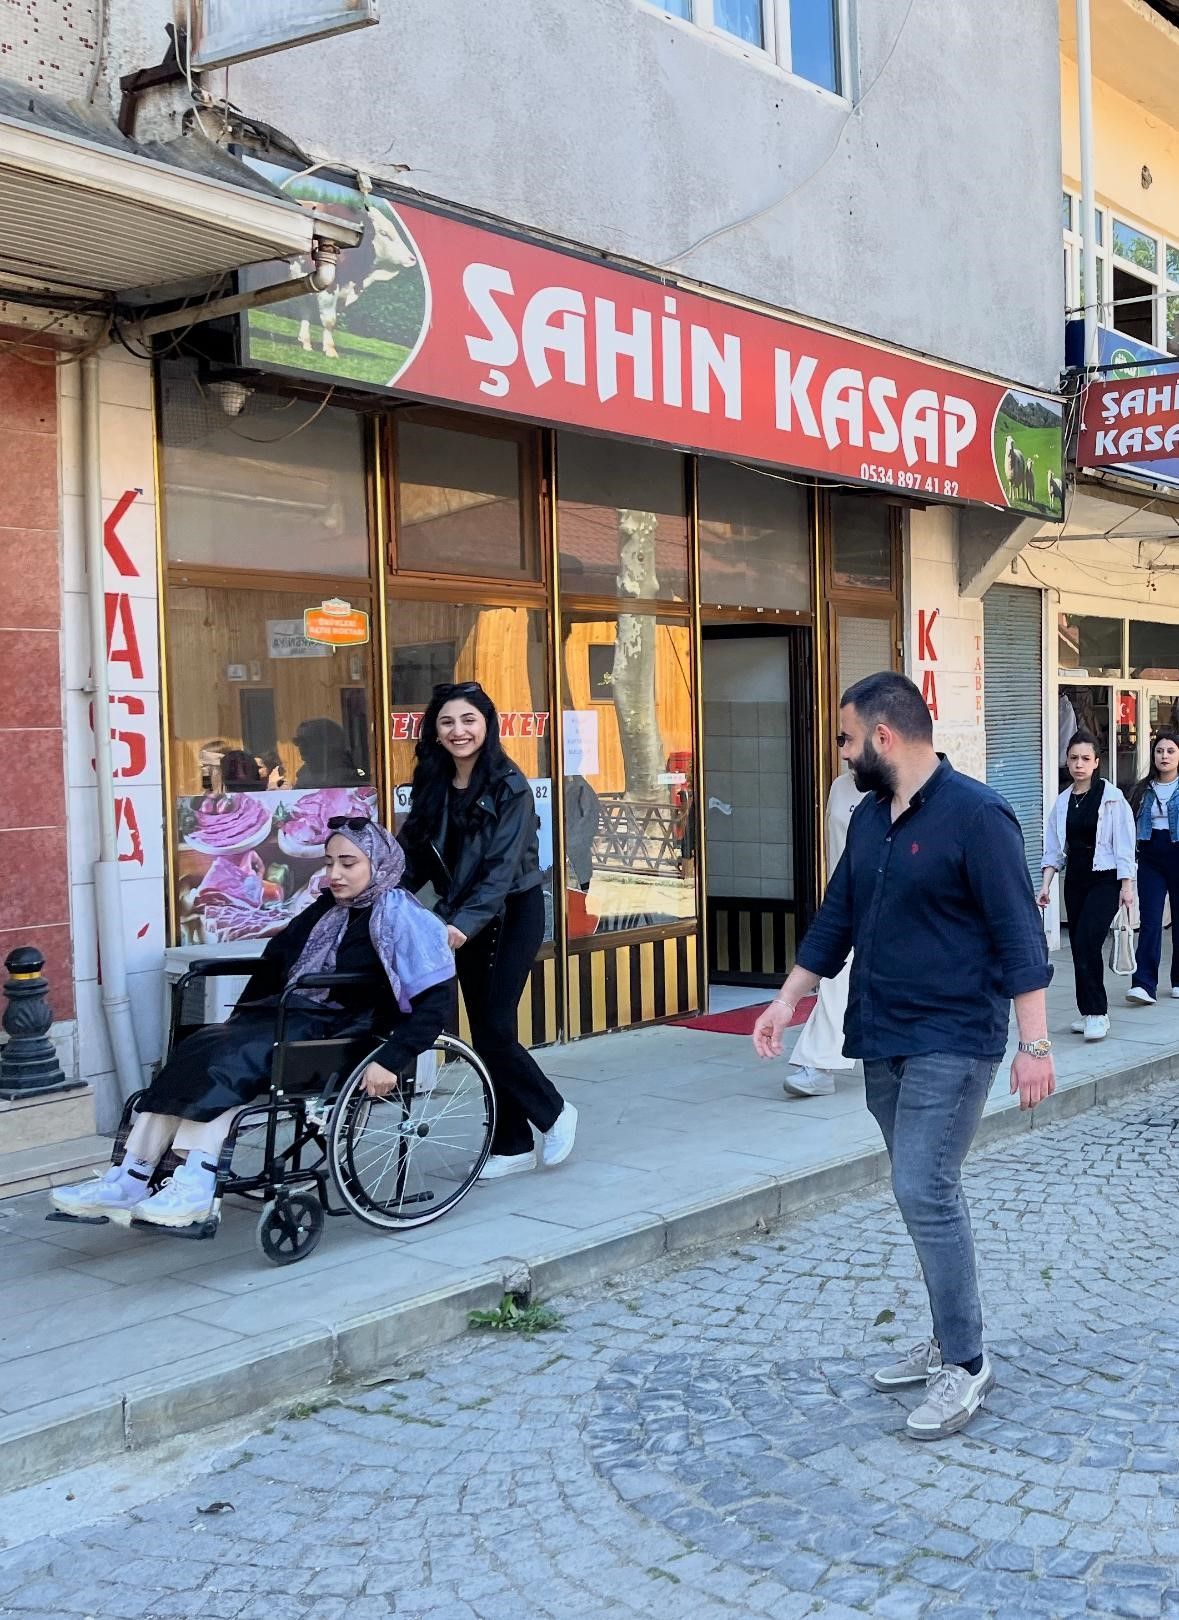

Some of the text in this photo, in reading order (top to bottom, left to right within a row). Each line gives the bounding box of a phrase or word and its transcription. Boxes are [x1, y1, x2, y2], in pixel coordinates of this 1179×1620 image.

[462, 262, 977, 467] ŞAHİN KASAP
[860, 462, 959, 497] 0534 897 41 82
[391, 712, 549, 739] ET KET
[535, 786, 548, 798] 82
